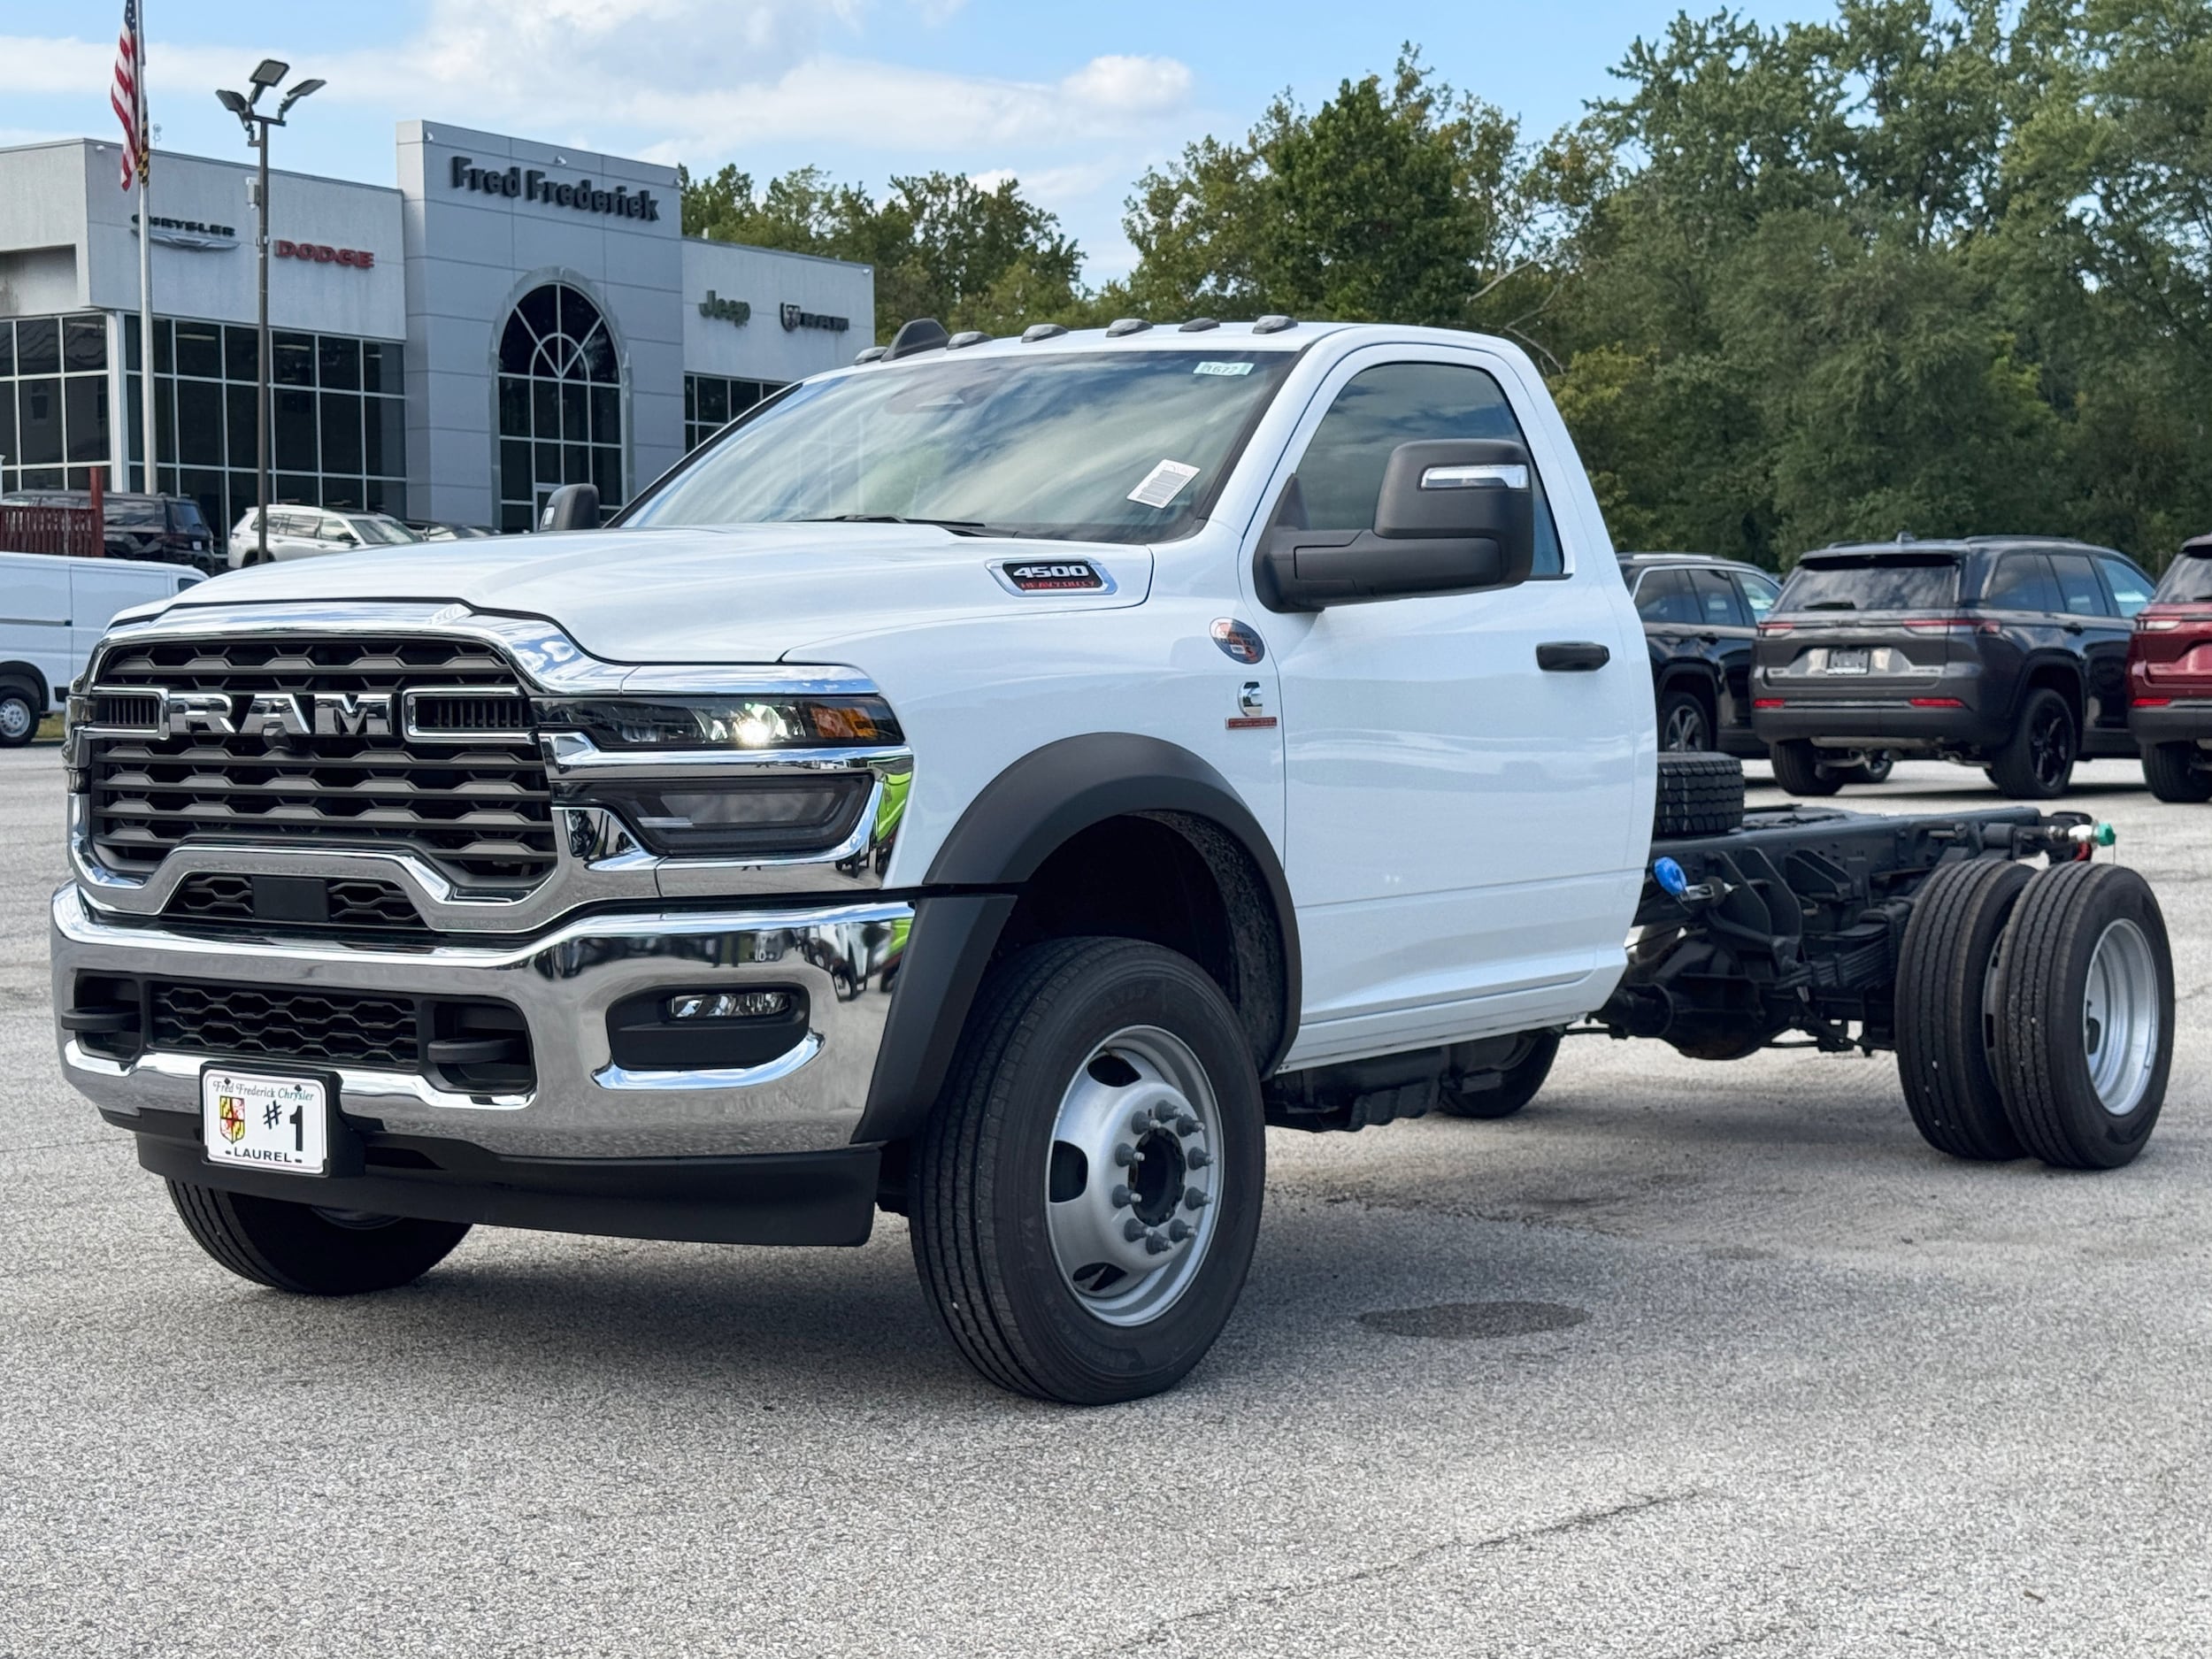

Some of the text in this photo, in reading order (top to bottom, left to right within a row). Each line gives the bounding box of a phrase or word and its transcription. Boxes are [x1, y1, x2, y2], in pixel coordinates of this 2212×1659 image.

[450, 155, 660, 221] Fred Frederick
[131, 213, 235, 236] CHRYSLER
[274, 239, 374, 269] DODGE
[698, 289, 751, 328] Jeep
[800, 311, 849, 333] RAM
[1013, 565, 1089, 579] 4500
[168, 693, 395, 735] RAM
[212, 1079, 314, 1102] Fred Frederick Chrysler
[234, 1147, 292, 1164] LAUREL
